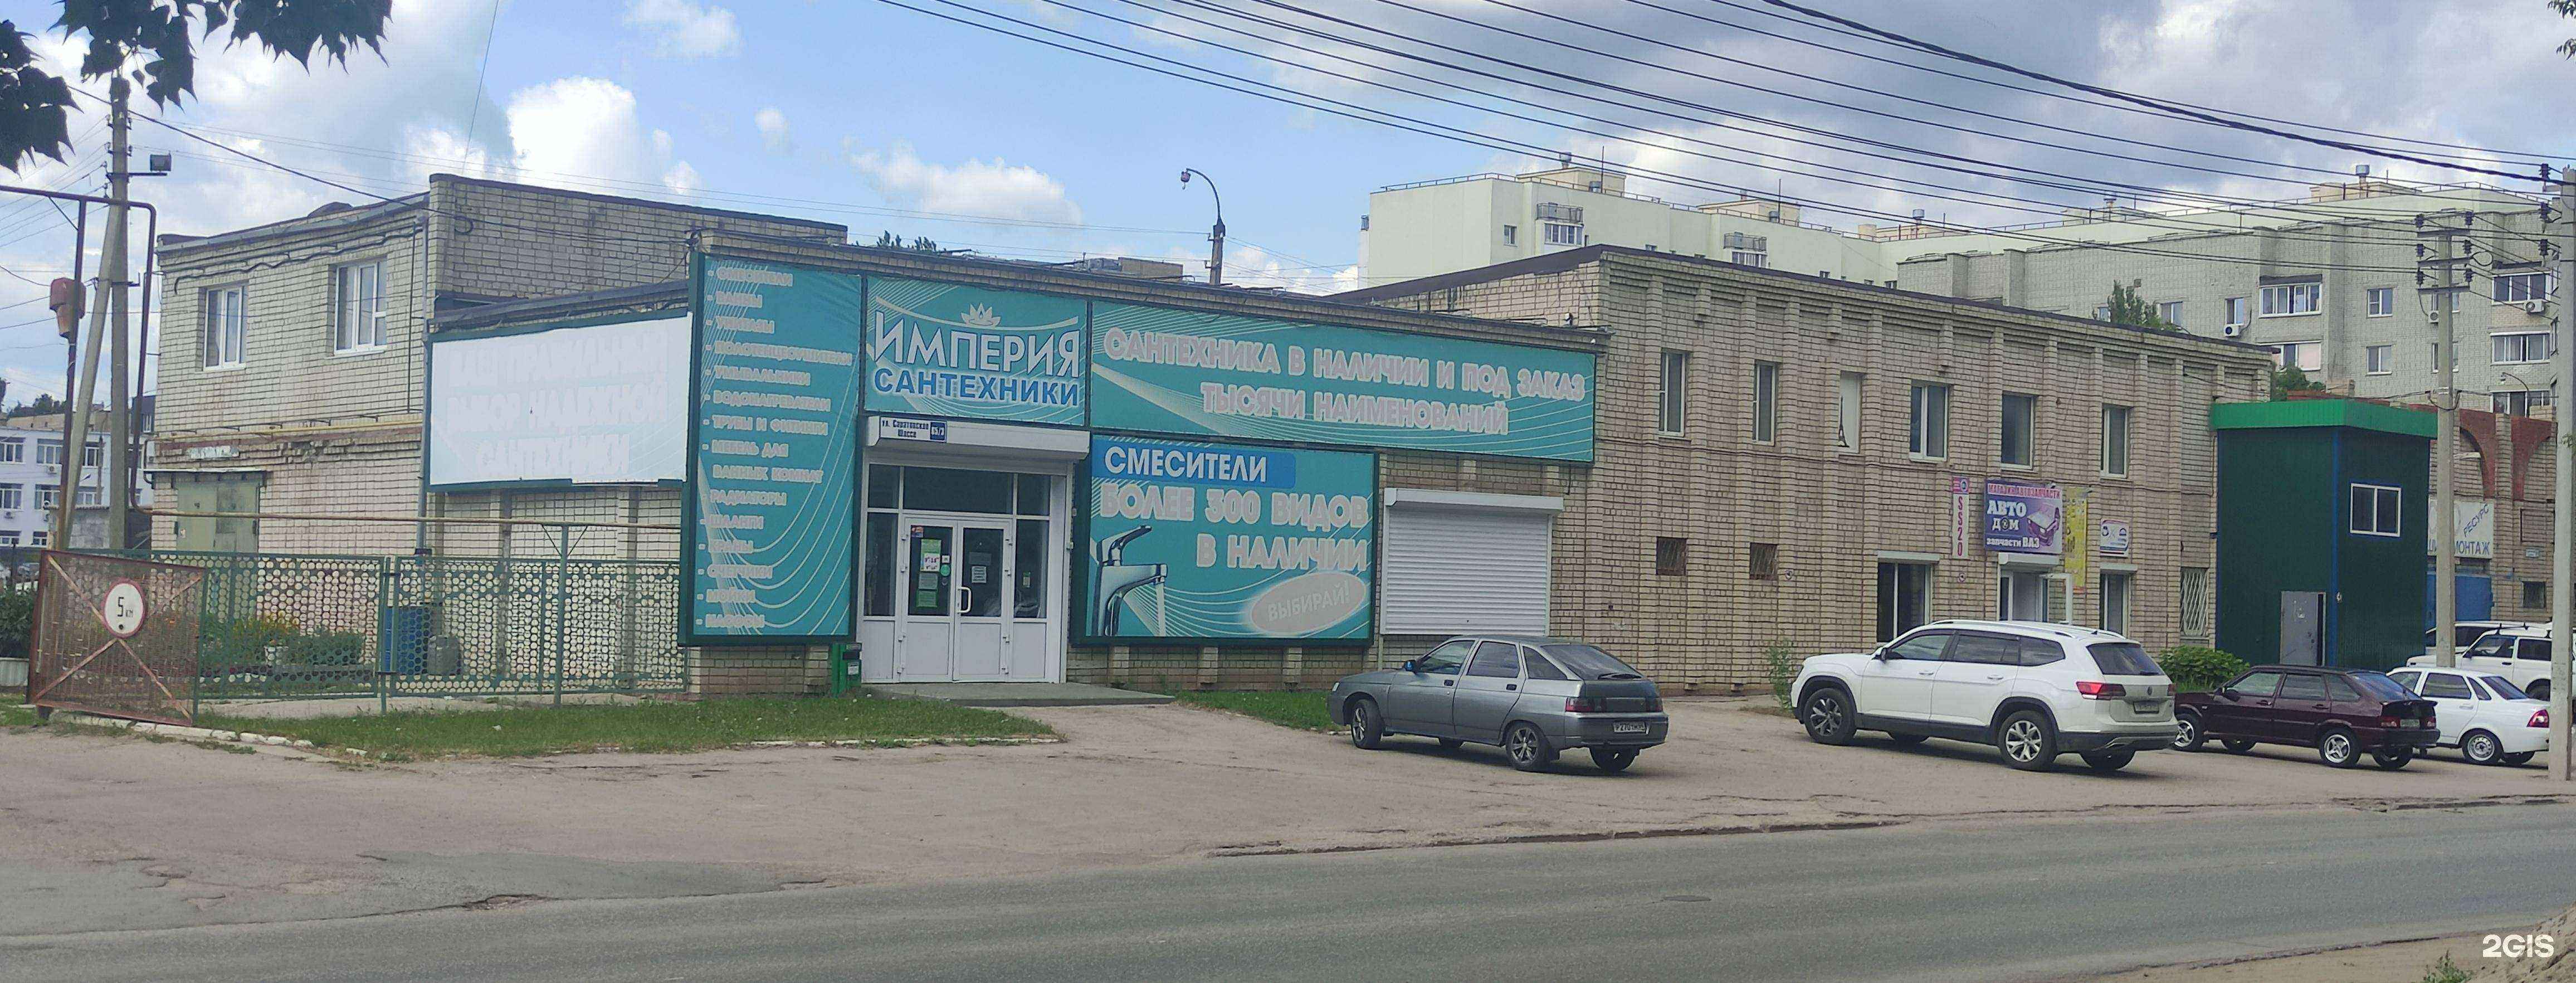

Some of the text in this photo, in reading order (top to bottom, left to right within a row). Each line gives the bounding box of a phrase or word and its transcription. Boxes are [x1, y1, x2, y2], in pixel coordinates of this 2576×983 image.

[874, 310, 1080, 378] ИМПЕРИЯ
[1104, 326, 1585, 402] САНТЕХНИКА В НАЛИЧИИ И ПОД ЗАКАЗ
[714, 390, 831, 412] ВОДОНАГРЕВАТЕЛИ
[874, 367, 1080, 407] САНТЕХНИКИ
[712, 415, 753, 430] ТРУБЫ
[756, 417, 767, 431] И
[1201, 382, 1509, 435] ТЫСЯЧИ НАИМЕНОВАНИЙ
[1104, 446, 1268, 483] СМЕСИТЕЛИ
[1100, 483, 1369, 532] БОЛЕЕ 300 ВИДОВ
[1987, 499, 2027, 518] АВТО
[1196, 533, 1367, 571] В НАЛИЧИИ
[2022, 537, 2040, 548] ВАЗ
[118, 596, 124, 617] 5
[1268, 580, 1351, 622] ВЫБИРАЙ!
